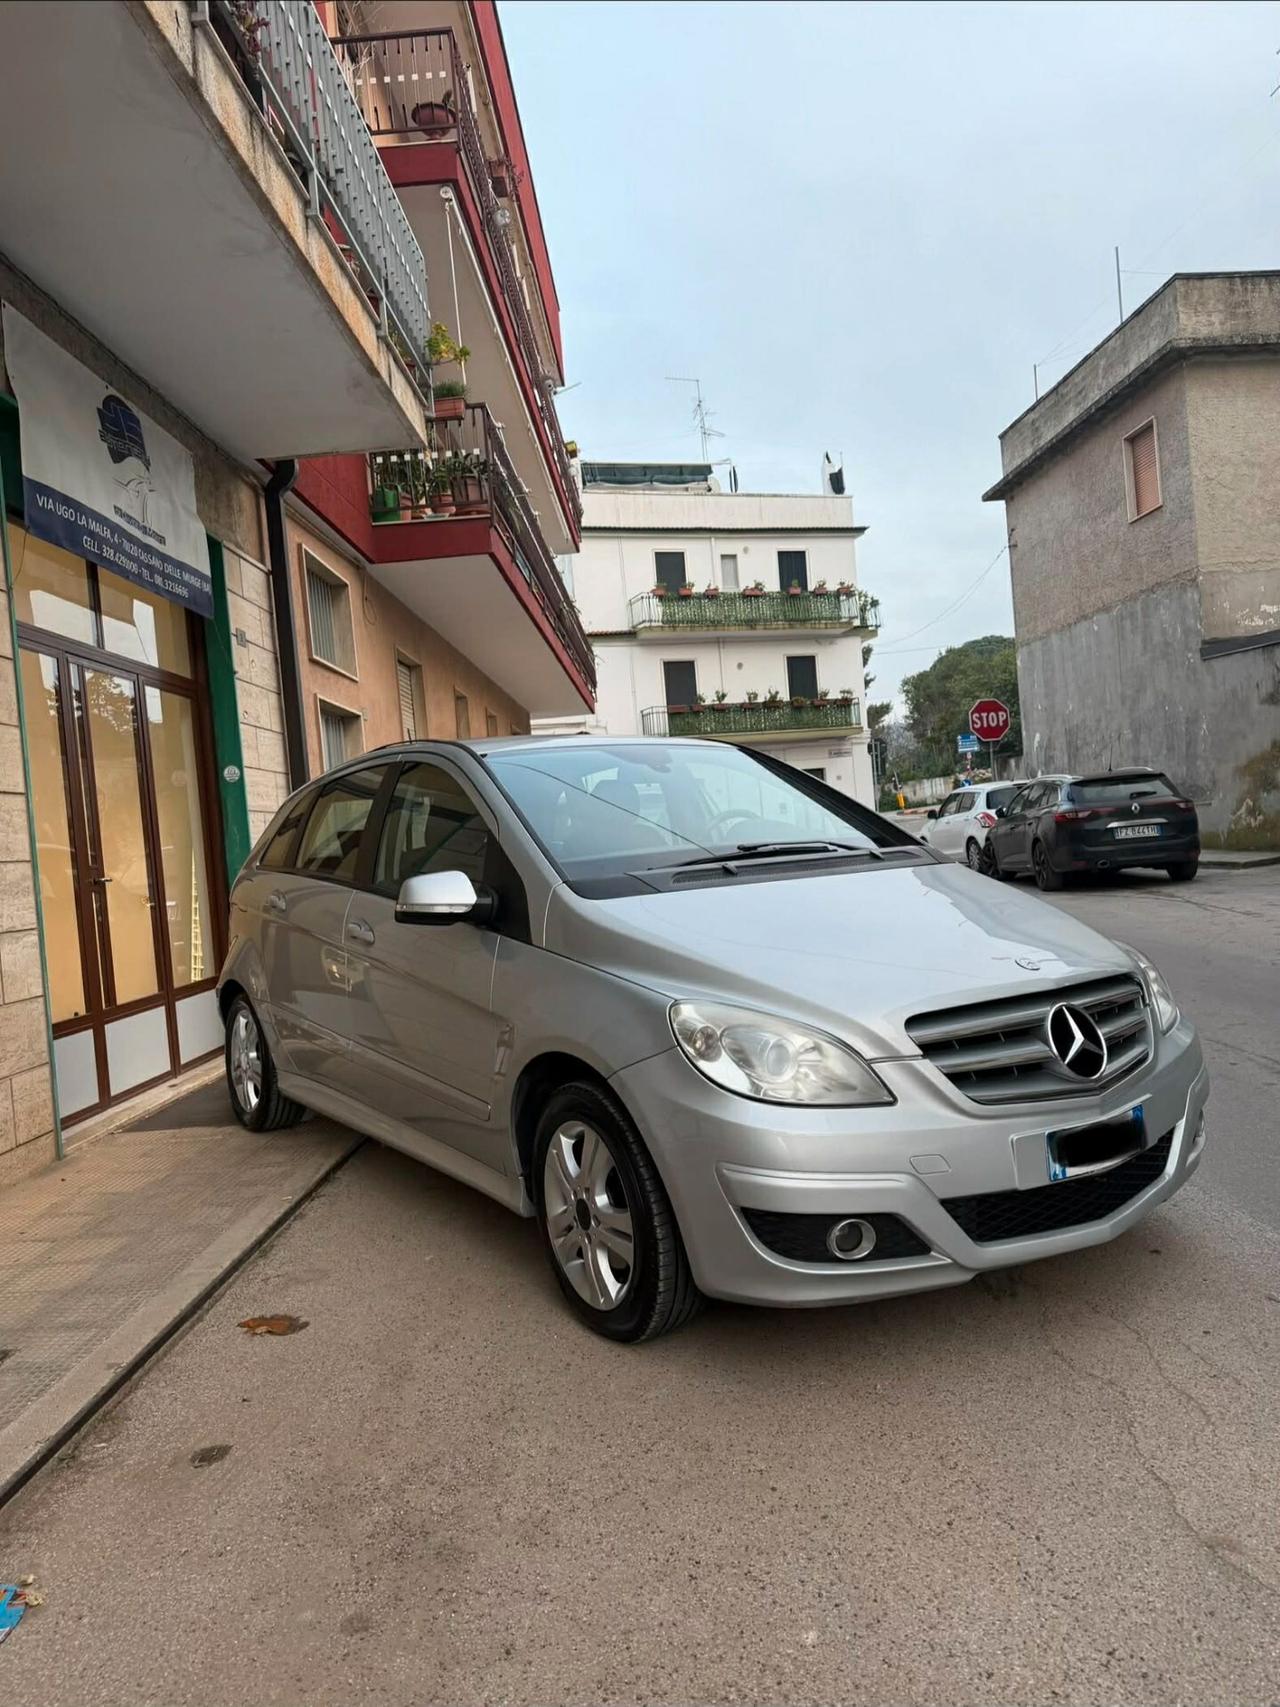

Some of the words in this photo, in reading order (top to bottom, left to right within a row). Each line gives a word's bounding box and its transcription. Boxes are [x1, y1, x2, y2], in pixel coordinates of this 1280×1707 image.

[36, 493, 55, 512] VIA
[56, 501, 75, 521] UGO
[77, 512, 87, 528] LA
[88, 518, 113, 543] MALFA,
[138, 549, 163, 571] CASSANO
[164, 562, 181, 580] DELLE
[82, 535, 100, 554] CELL.
[972, 711, 1007, 728] STOP
